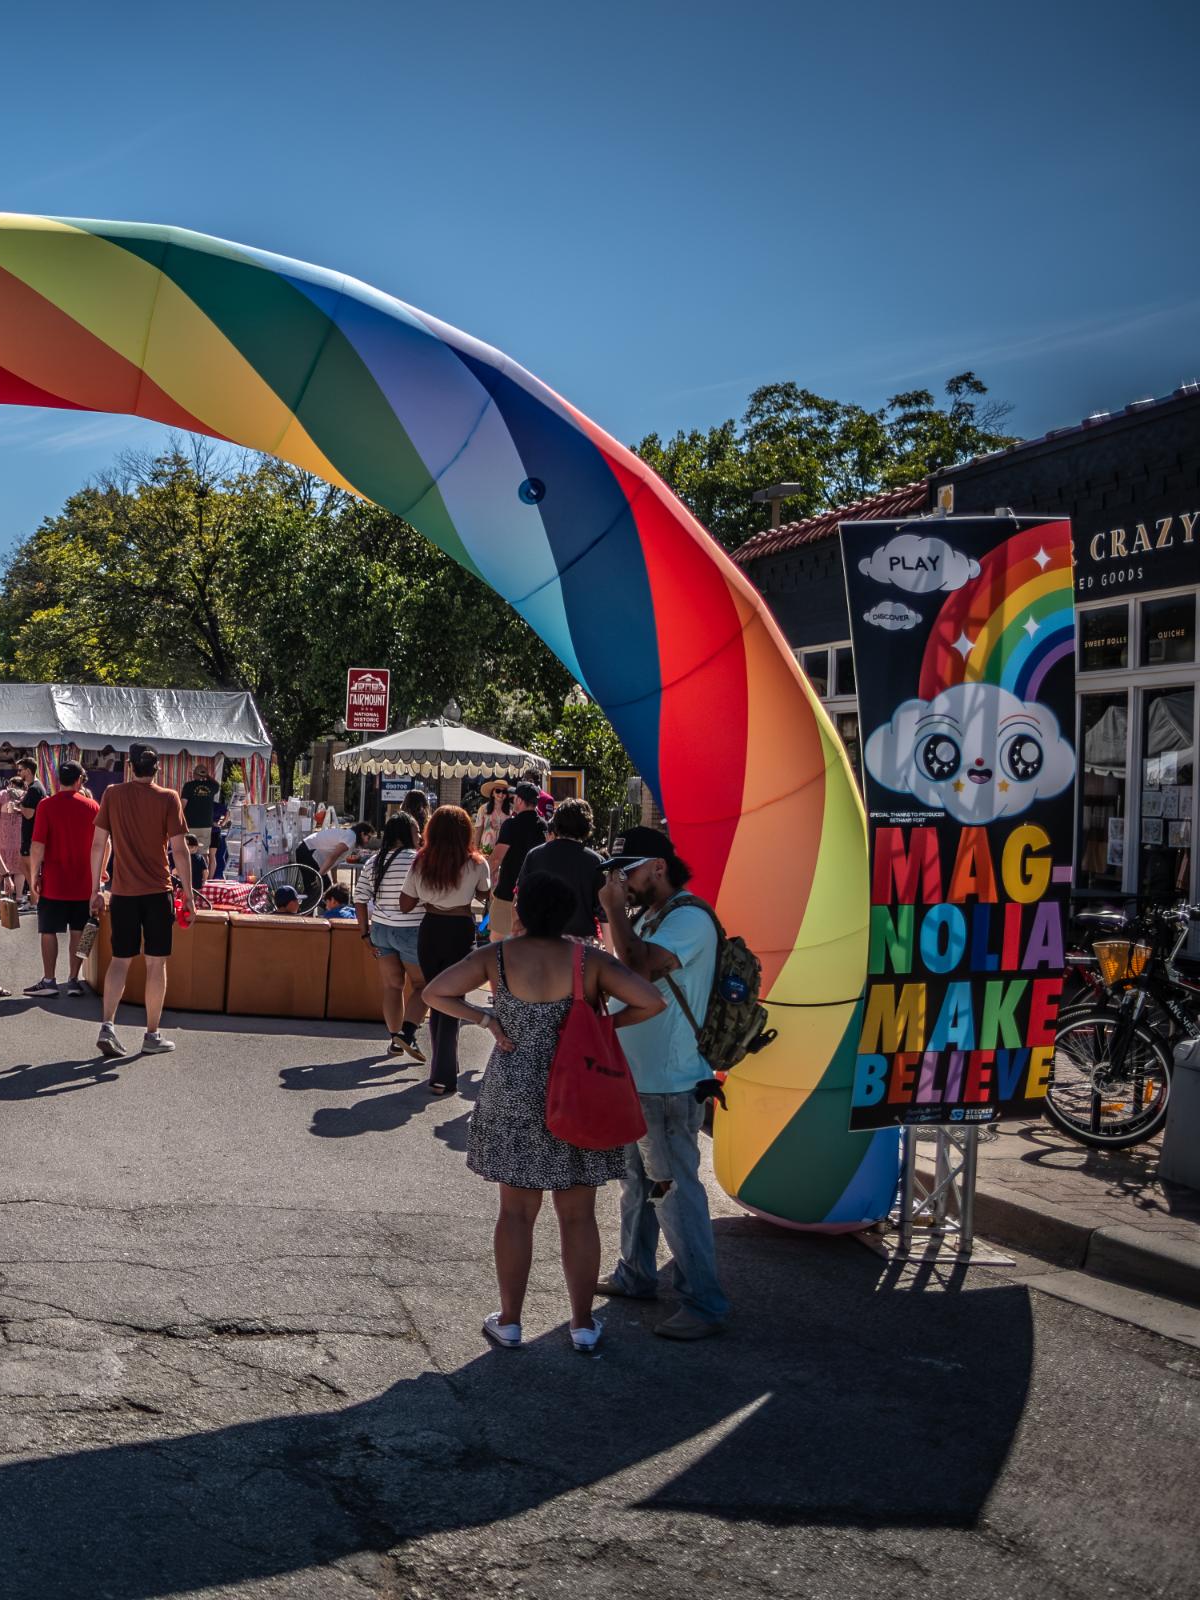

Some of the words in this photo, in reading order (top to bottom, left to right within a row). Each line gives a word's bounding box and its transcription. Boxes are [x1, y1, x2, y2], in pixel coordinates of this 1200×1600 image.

[1089, 511, 1200, 561] CRAZY
[889, 555, 940, 572] PLAY
[1079, 578, 1094, 590] ED
[1101, 567, 1144, 586] GOODS
[872, 613, 909, 621] DISCOVER
[1084, 640, 1105, 648] SWEET
[1106, 637, 1128, 645] ROLLS
[1157, 629, 1185, 639] QUICHE
[349, 693, 386, 706] FAIRMOUNT
[872, 825, 1073, 904] MAG-
[868, 901, 1064, 974] NOLIA
[857, 978, 1063, 1053] MAKE
[851, 1046, 1055, 1107] BELIEVE
